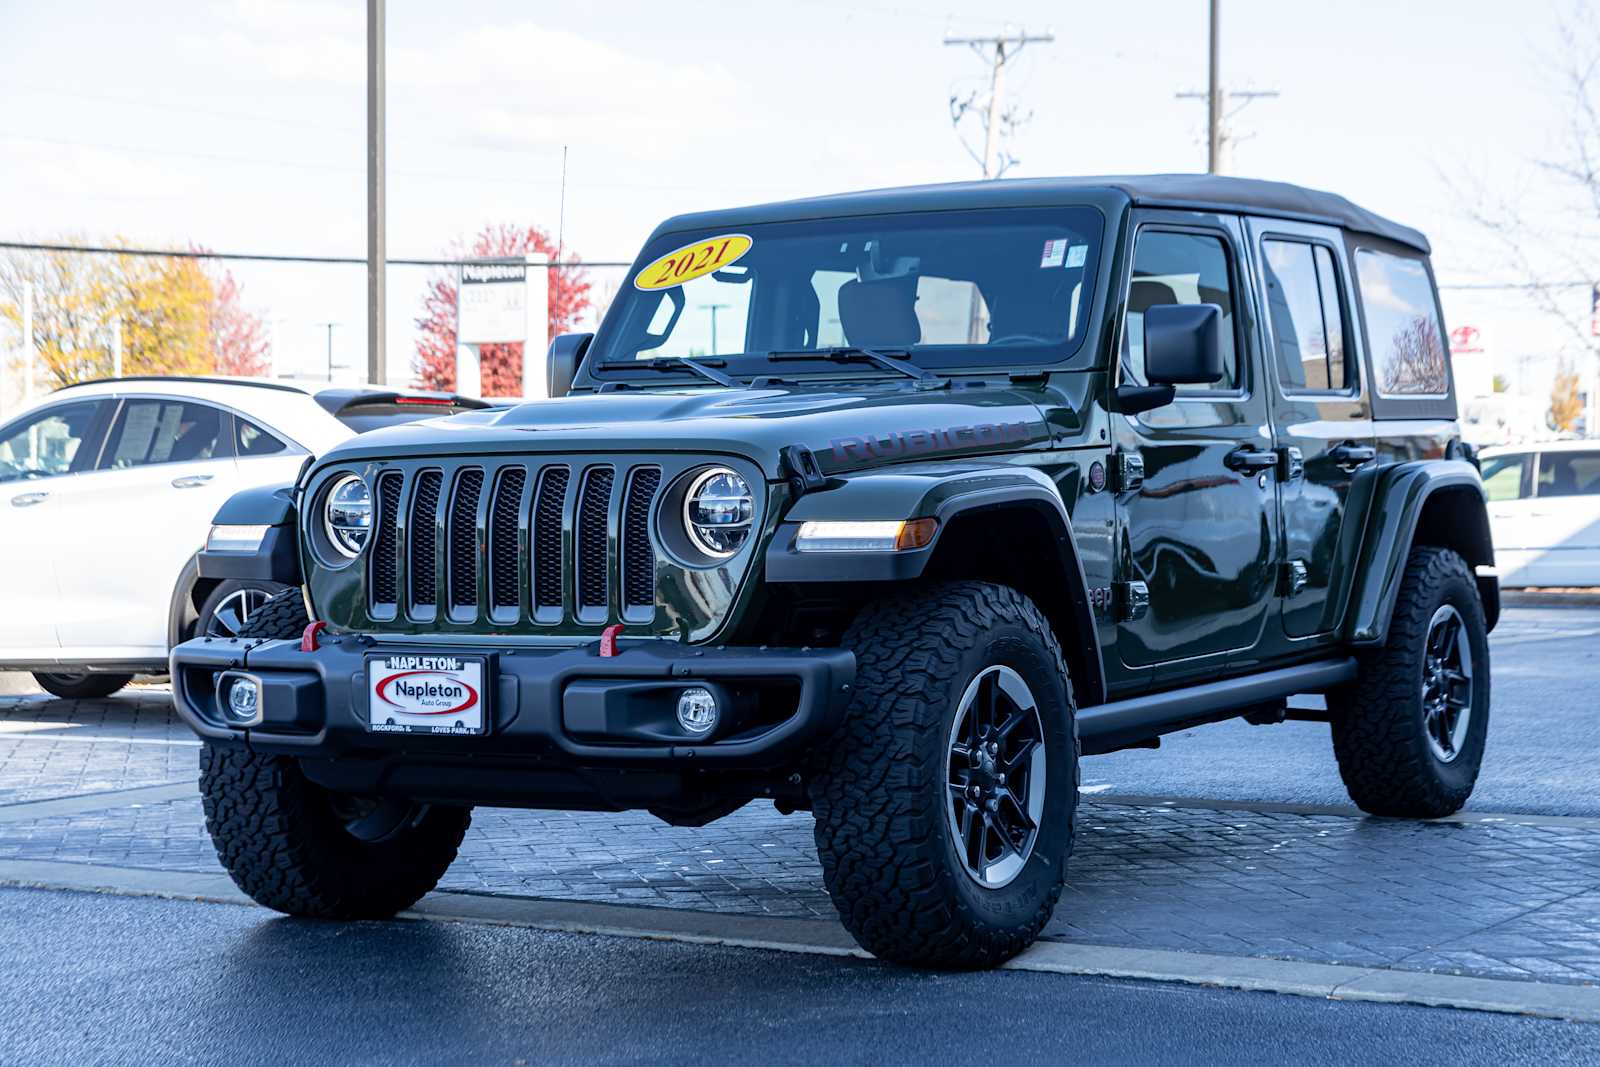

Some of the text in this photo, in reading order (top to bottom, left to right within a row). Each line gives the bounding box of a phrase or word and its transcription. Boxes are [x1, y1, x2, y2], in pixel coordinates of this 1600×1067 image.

[653, 239, 731, 285] 2021
[463, 264, 525, 282] Napleton
[830, 420, 1034, 462] RUBICON
[1087, 584, 1113, 611] eep
[390, 656, 457, 670] NAPLETON
[395, 680, 462, 700] Napleton
[435, 699, 452, 708] Group
[431, 726, 451, 734] LOVES
